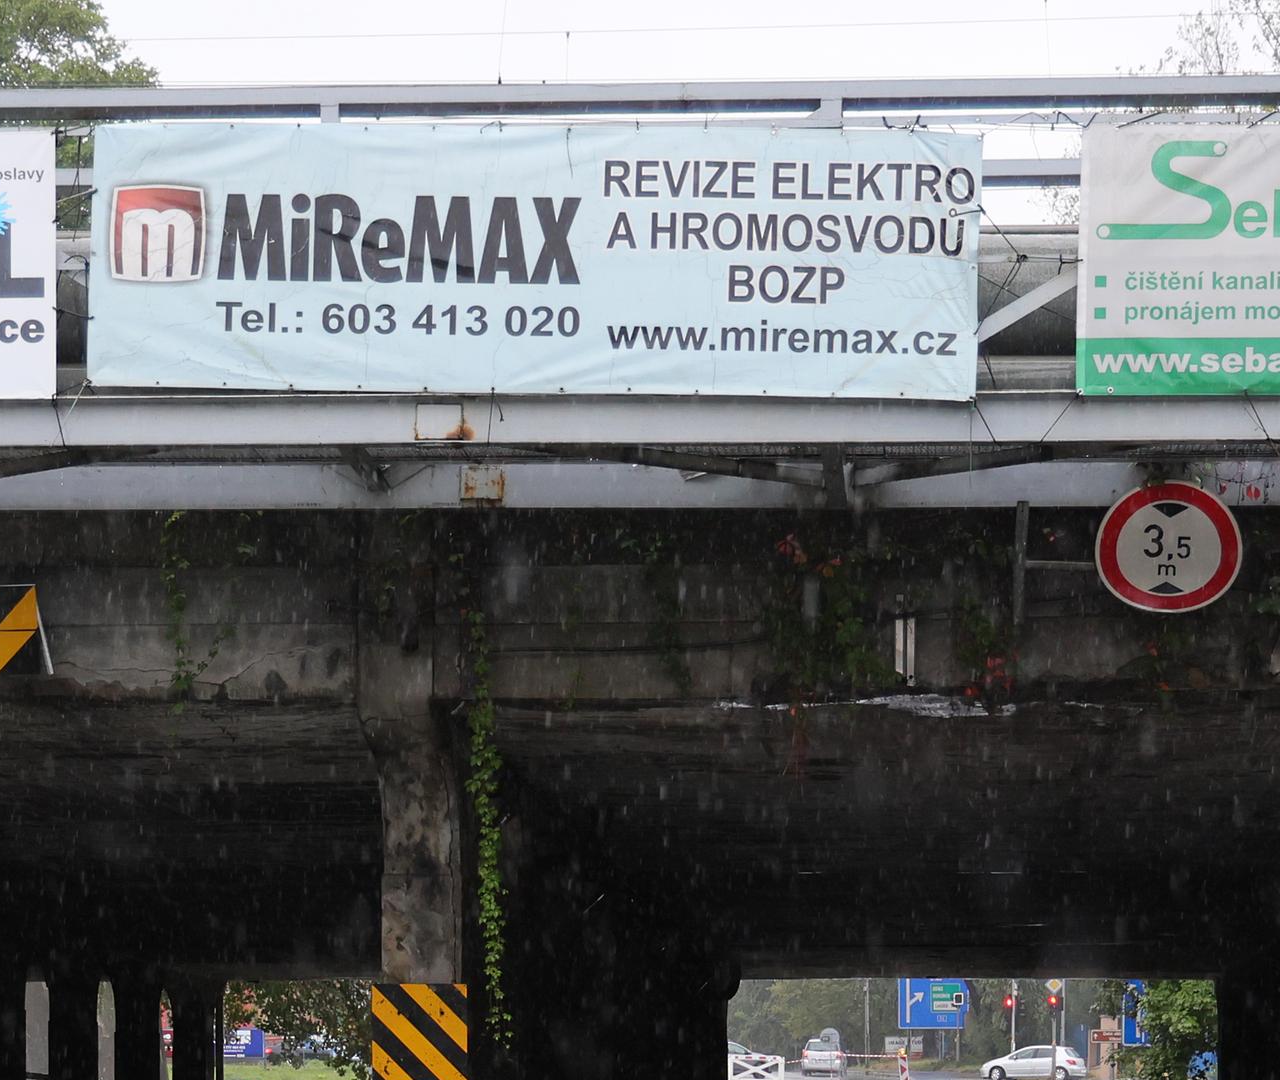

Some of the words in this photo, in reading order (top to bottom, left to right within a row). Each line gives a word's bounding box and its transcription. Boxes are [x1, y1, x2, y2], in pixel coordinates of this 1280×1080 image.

[603, 160, 756, 199] REVIZE
[771, 162, 975, 204] ELEKTRO
[217, 193, 582, 284] MiReMAX
[606, 211, 637, 249] A
[727, 264, 846, 304] BOZP
[1124, 270, 1204, 291] čištění
[216, 302, 304, 333] Tel.:
[321, 303, 397, 335] 603
[412, 304, 489, 336] 413
[504, 305, 580, 337] 020
[1124, 301, 1236, 325] pronájem
[607, 319, 958, 356] www.miremax.cz
[1143, 524, 1192, 561] 3,5
[1157, 563, 1177, 577] m
